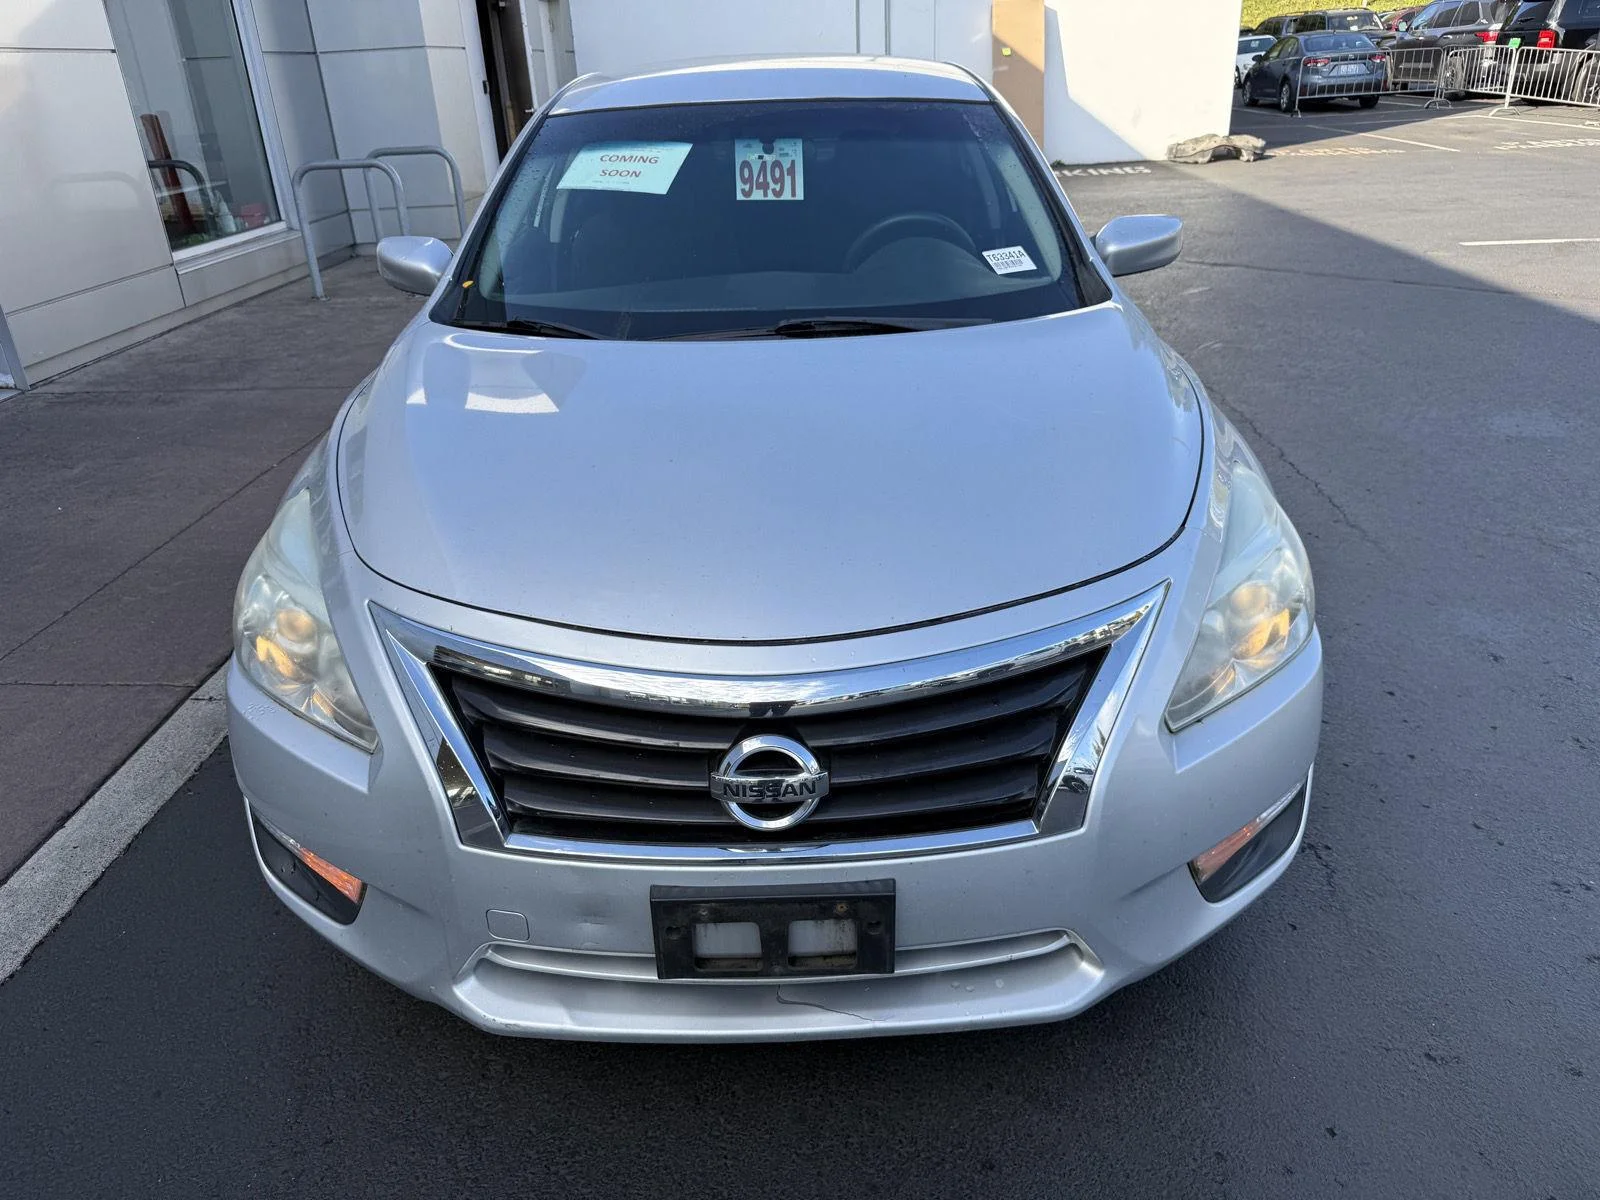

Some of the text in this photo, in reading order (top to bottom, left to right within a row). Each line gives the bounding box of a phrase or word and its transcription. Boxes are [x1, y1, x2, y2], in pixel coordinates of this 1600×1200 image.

[600, 154, 660, 164] COMING
[599, 169, 642, 178] SOON
[739, 159, 796, 199] 9491
[723, 781, 816, 798] NISSAN
